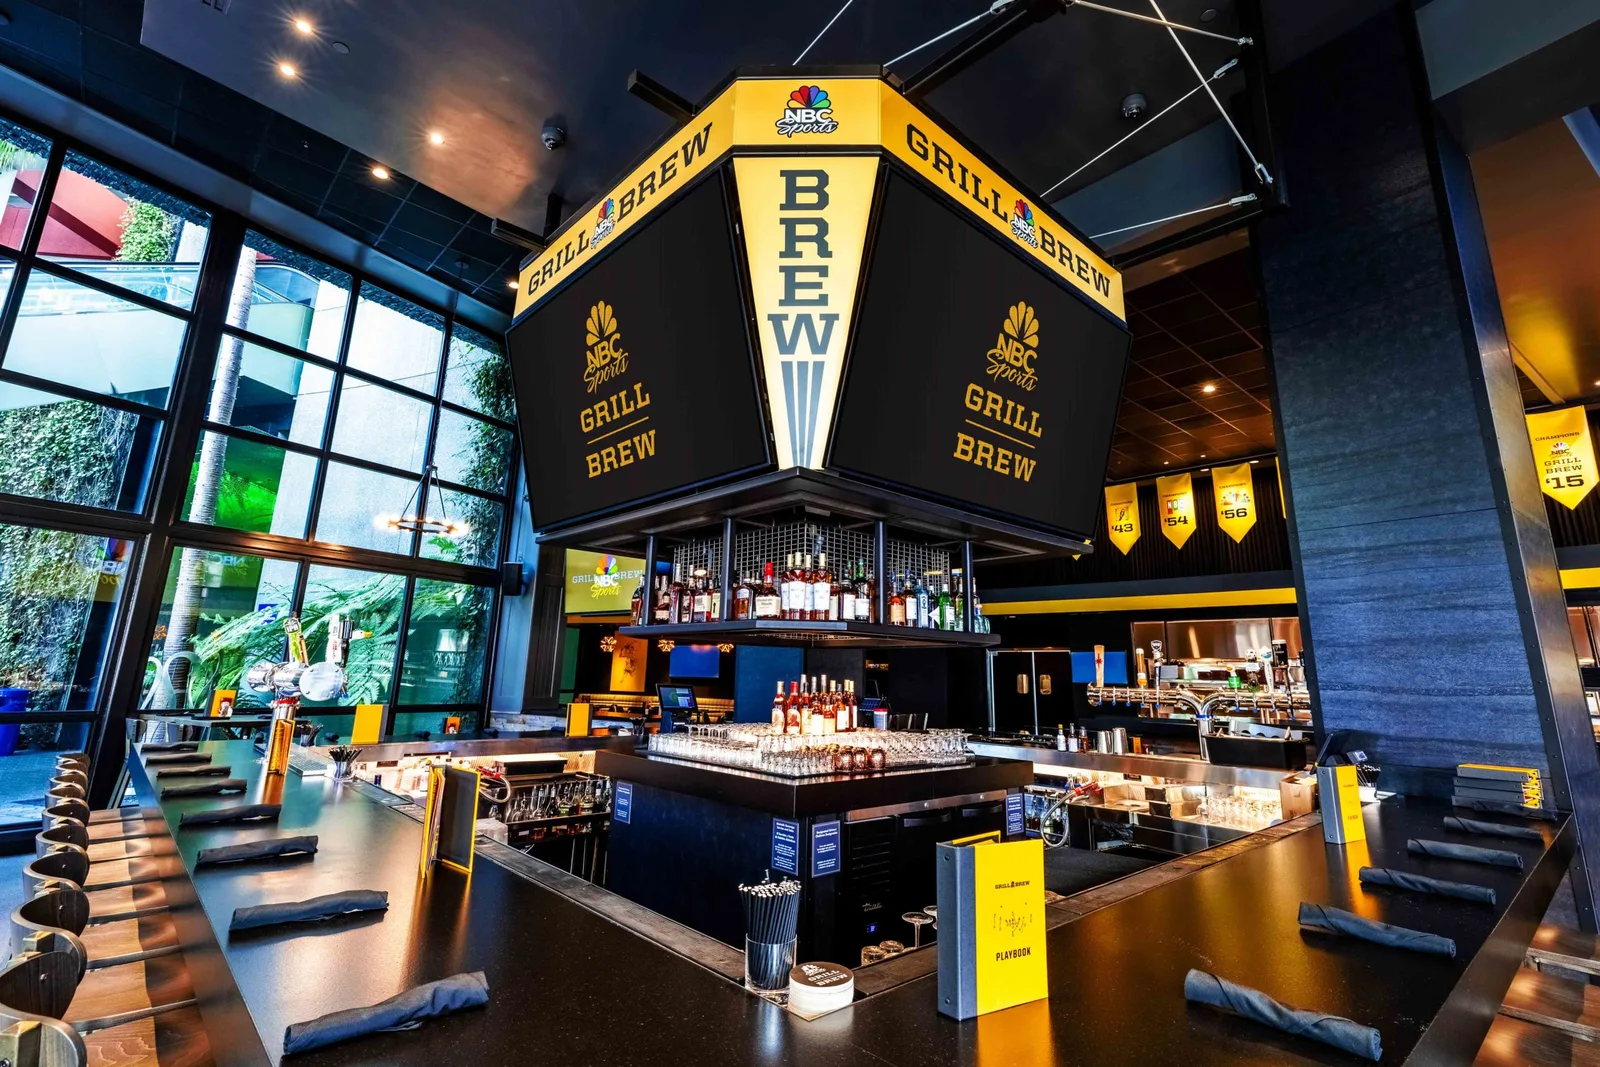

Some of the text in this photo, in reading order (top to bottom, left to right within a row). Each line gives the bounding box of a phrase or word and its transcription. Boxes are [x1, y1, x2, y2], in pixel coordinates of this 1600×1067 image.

[775, 118, 838, 137] Sports
[784, 108, 833, 123] NBC
[527, 121, 713, 297] GRILL BREW
[906, 123, 1111, 298] GRILL BREW
[594, 213, 615, 239] NBC
[1010, 219, 1039, 248] Sports
[1013, 213, 1036, 236] NBC
[767, 169, 840, 355] BREW
[585, 332, 623, 368] NBC
[996, 332, 1039, 374] NBC
[583, 349, 629, 394] Sports
[986, 348, 1039, 392] Sports
[580, 382, 651, 433] GRILL
[965, 382, 1043, 438] GRILL
[1535, 432, 1579, 441] CHAMPIONS
[585, 429, 656, 479] BREW
[953, 431, 1036, 482] BREW
[1544, 458, 1581, 466] GRILL
[1546, 465, 1582, 474] BREW
[590, 584, 622, 600] Sports
[594, 574, 619, 588] NBC
[995, 946, 1031, 962] PLAYBOOK
[808, 970, 840, 982] GRILL
[816, 973, 848, 986] BREW
